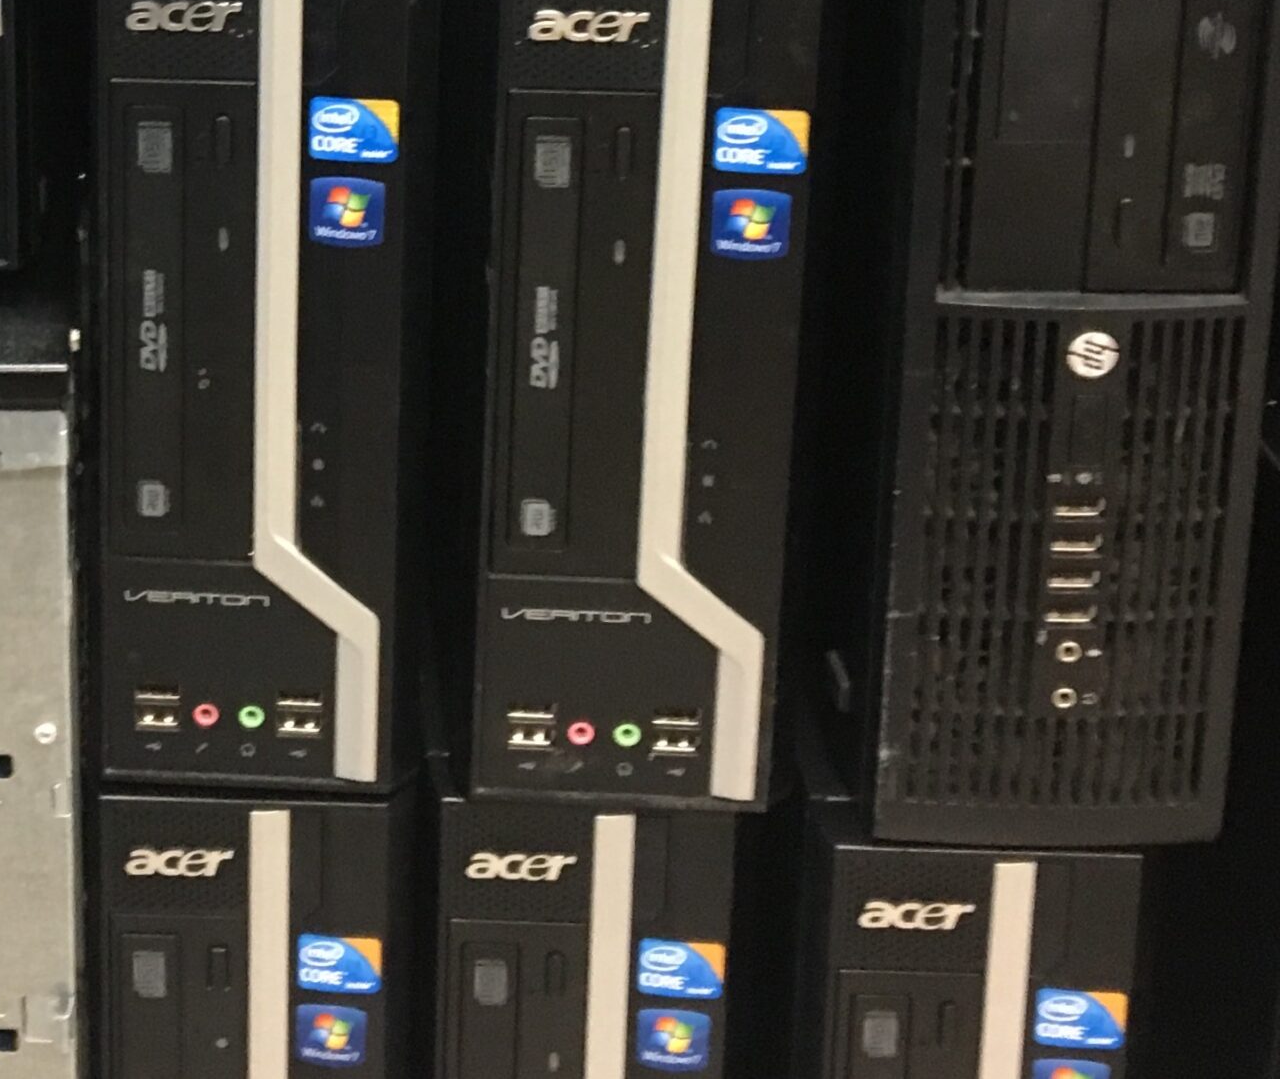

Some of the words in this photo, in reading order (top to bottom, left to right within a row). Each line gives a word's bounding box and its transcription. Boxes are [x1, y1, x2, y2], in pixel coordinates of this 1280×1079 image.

[125, 1, 243, 32] acer
[527, 9, 651, 42] acer
[311, 135, 359, 154] CORE
[715, 147, 766, 165] CORE
[313, 224, 368, 241] Windows
[367, 229, 377, 241] 7
[715, 239, 773, 253] Windows
[529, 336, 550, 389] DVD
[1067, 339, 1119, 371] hp
[123, 849, 235, 877] acer
[464, 852, 578, 881] acer
[857, 901, 976, 930] acer
[299, 968, 343, 985] CORE
[640, 972, 685, 990] CORE
[1035, 1023, 1085, 1041] CORE
